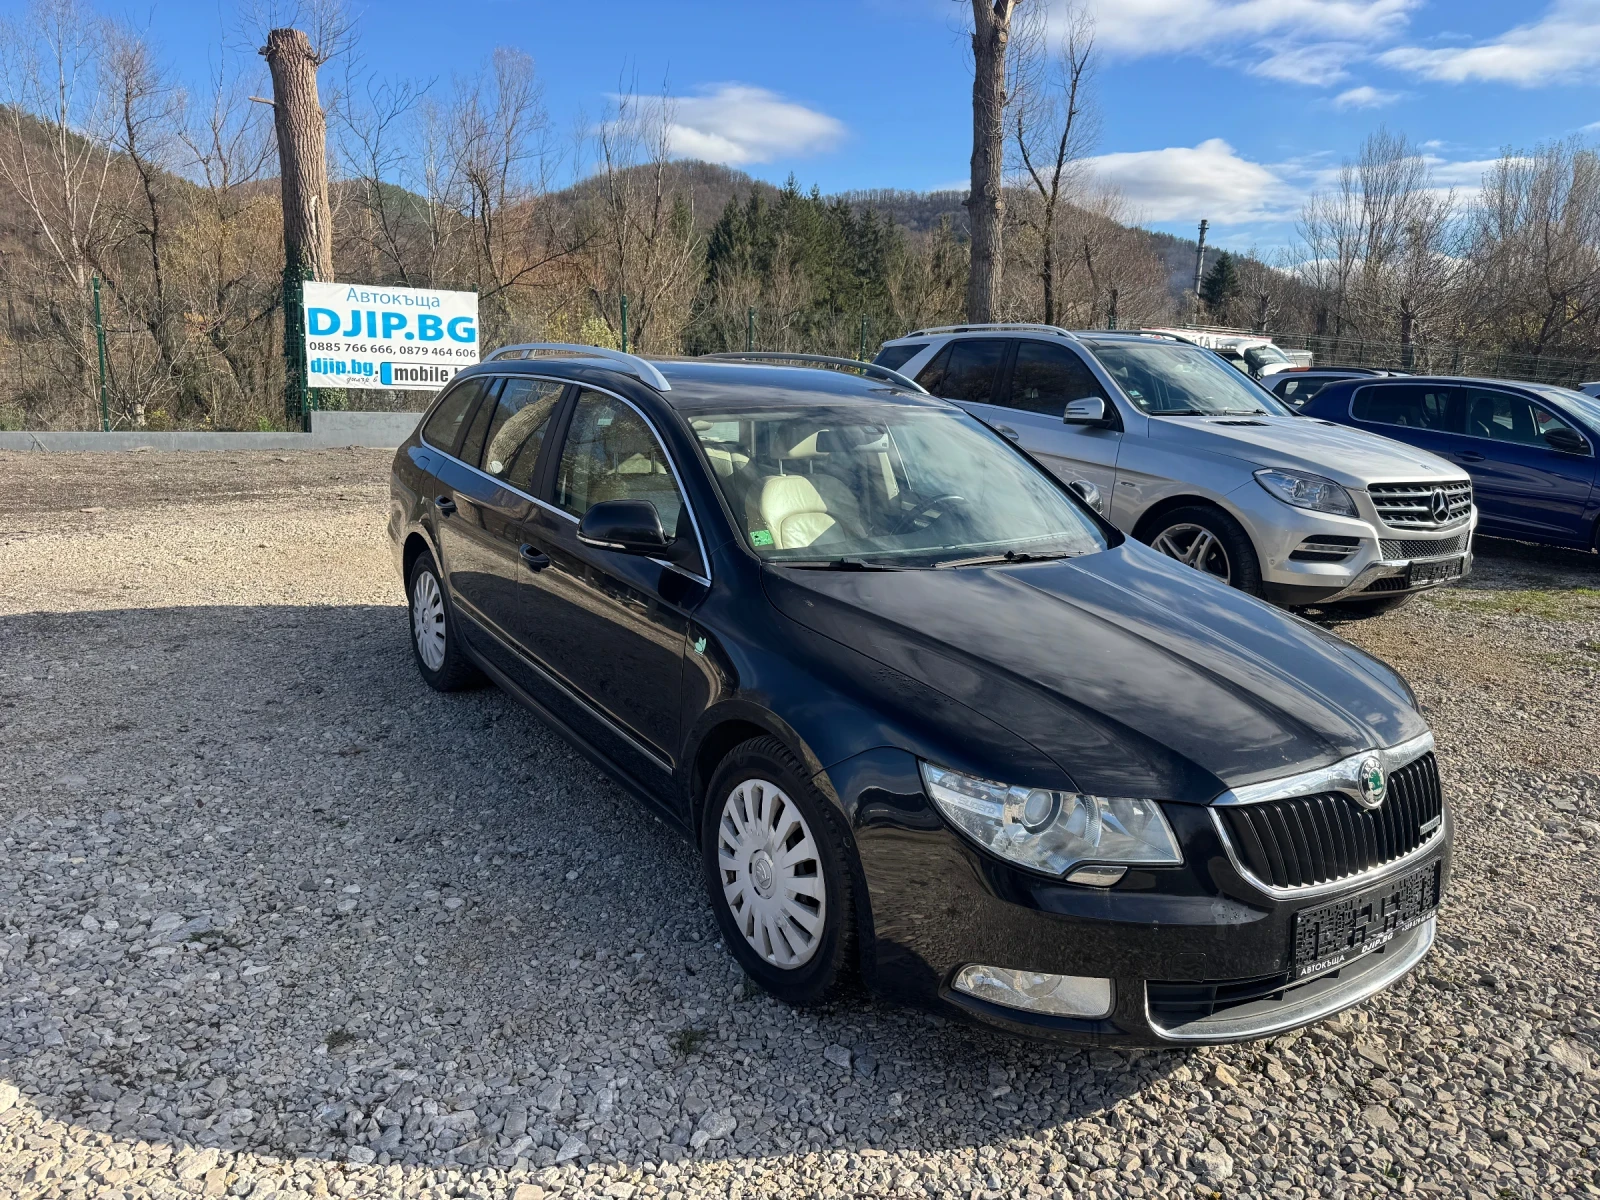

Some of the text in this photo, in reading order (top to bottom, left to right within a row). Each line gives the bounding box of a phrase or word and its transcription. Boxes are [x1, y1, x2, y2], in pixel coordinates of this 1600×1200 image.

[346, 287, 440, 309] Автокъща
[307, 307, 476, 343] DJIP.BG
[309, 341, 477, 358] 0885 766 666, 0879 464 606
[394, 365, 460, 383] mobile
[1361, 932, 1394, 954] DJIP.BG
[1300, 954, 1346, 976] АВТОКЪЩА
